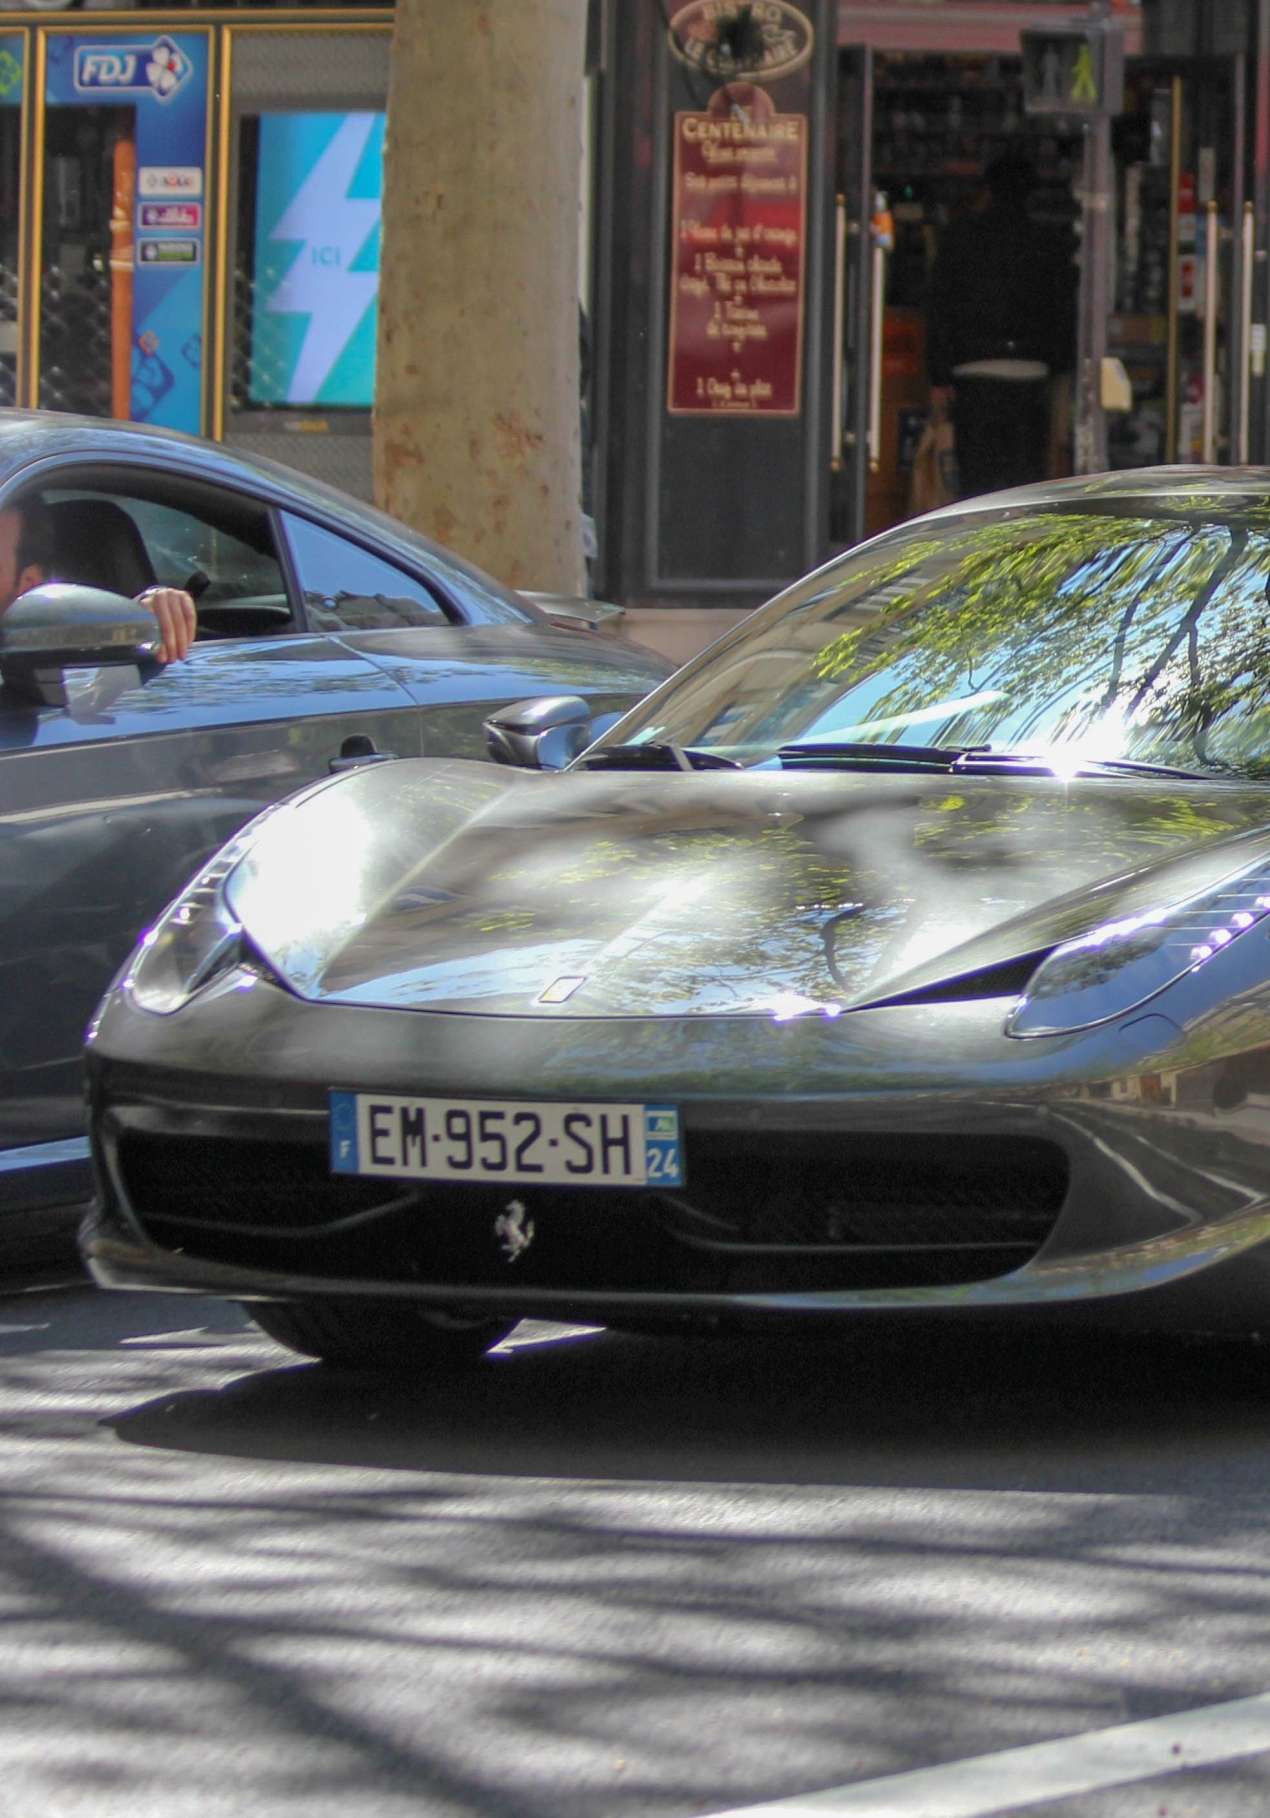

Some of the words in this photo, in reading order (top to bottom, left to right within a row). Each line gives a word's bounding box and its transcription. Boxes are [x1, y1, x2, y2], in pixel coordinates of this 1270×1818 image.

[702, 3, 783, 23] BISRO
[82, 54, 137, 85] FDJ
[682, 117, 799, 142] CENTENAIRE
[311, 246, 341, 266] ICI
[339, 1140, 350, 1158] F
[646, 1148, 680, 1178] 24
